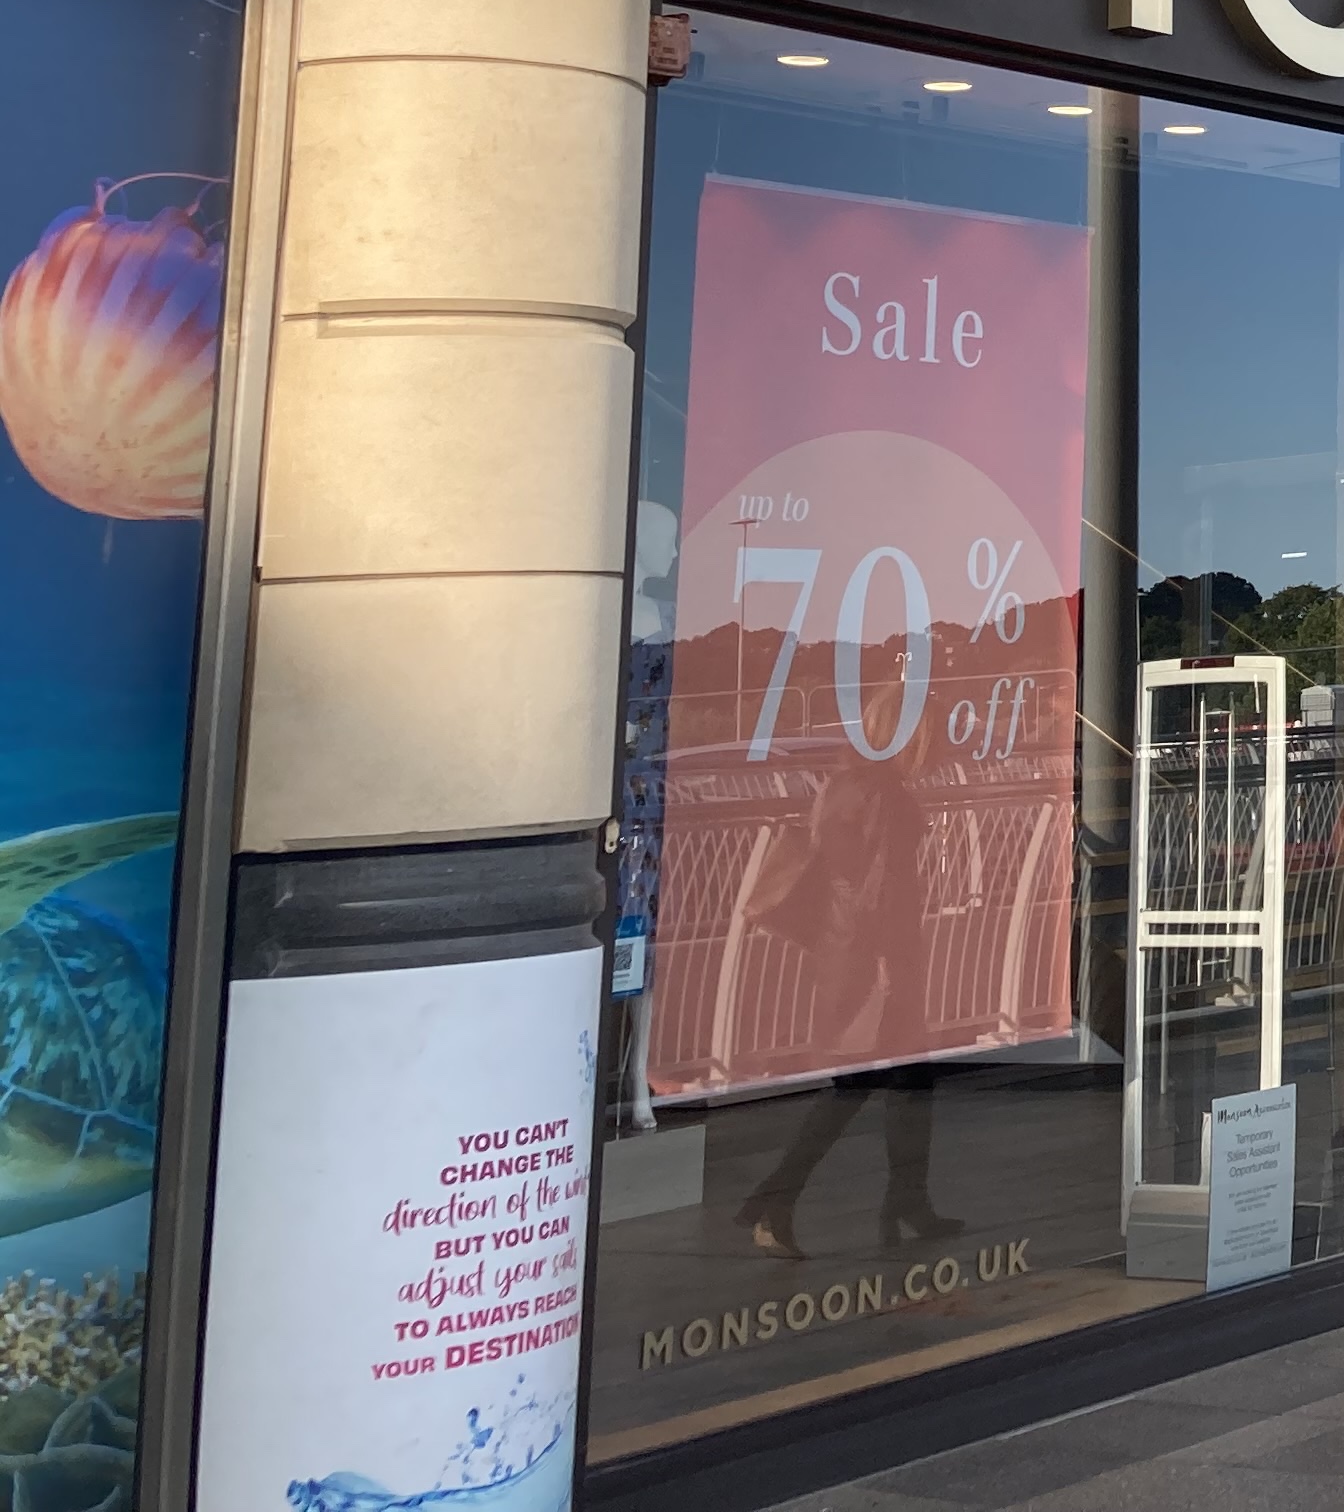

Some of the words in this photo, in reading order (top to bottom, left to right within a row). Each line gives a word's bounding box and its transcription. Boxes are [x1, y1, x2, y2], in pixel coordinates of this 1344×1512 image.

[821, 271, 985, 368] Sale
[738, 493, 774, 525] up
[780, 492, 810, 523] to
[947, 676, 1035, 761] off
[458, 1129, 509, 1155] YOU
[515, 1118, 569, 1147] CAN'T
[440, 1151, 541, 1186] CHANGE
[545, 1144, 575, 1168] THE
[382, 1190, 497, 1236] direction
[506, 1179, 530, 1222] of
[536, 1174, 561, 1213] the
[434, 1234, 487, 1261] BUT
[491, 1224, 535, 1250] YOU
[538, 1215, 570, 1241] CAN
[397, 1259, 486, 1309] adjust
[494, 1255, 548, 1299] your
[638, 1237, 1031, 1372] MONSOON.CO.UK
[393, 1319, 430, 1342] TO
[435, 1298, 531, 1337] ALWAYS
[371, 1356, 436, 1381] YOUR
